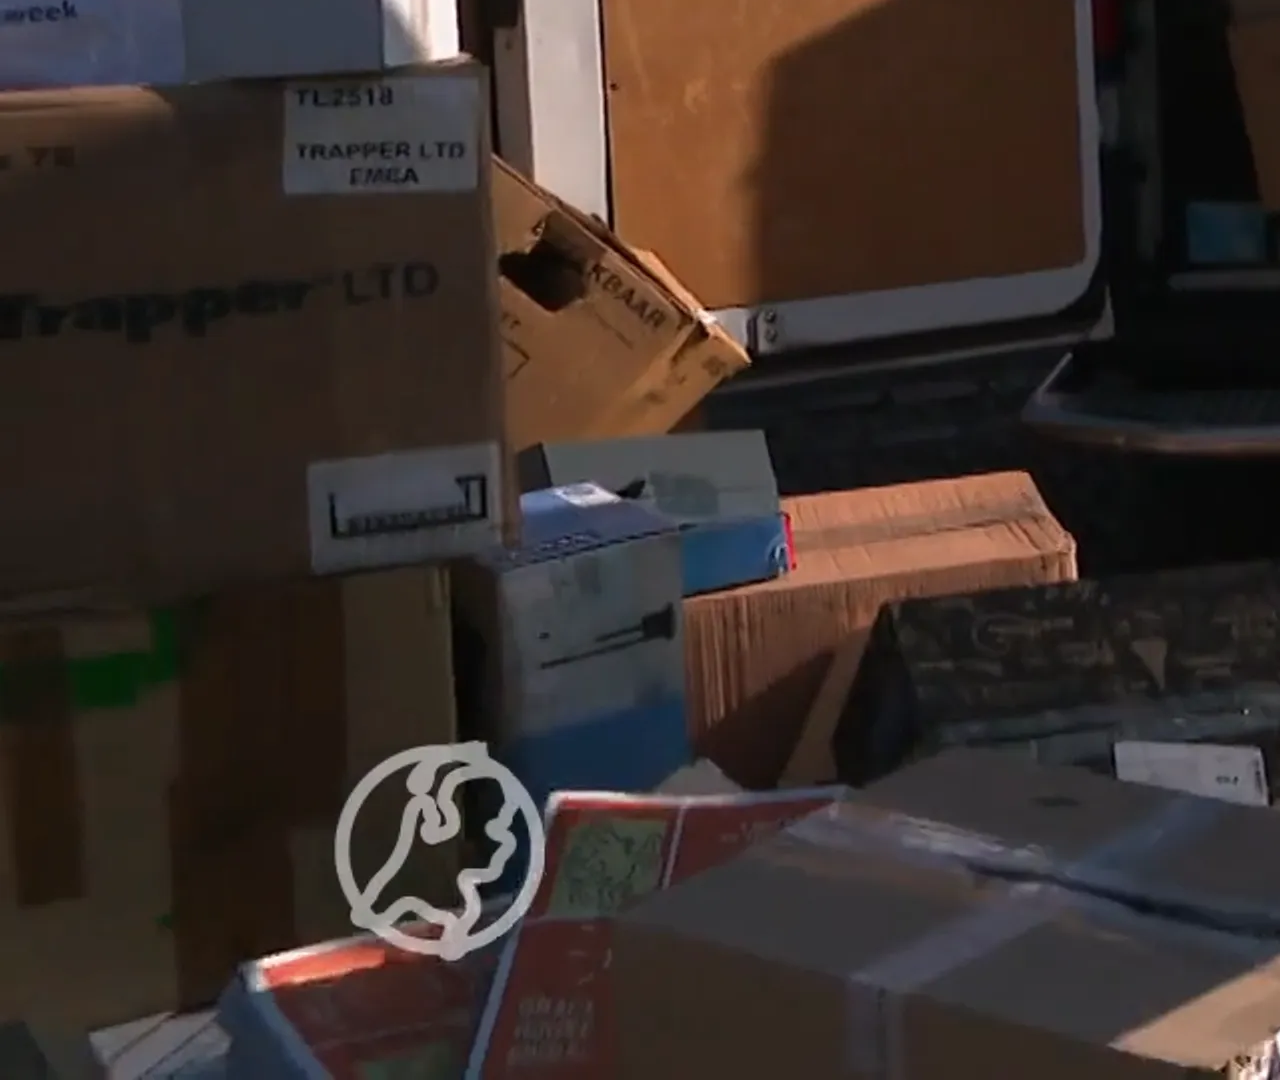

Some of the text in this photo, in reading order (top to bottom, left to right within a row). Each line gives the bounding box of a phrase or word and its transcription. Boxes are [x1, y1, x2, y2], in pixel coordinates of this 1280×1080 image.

[297, 86, 394, 108] TL2518
[296, 139, 467, 161] TRAPPER LTD
[342, 261, 440, 307] LTD
